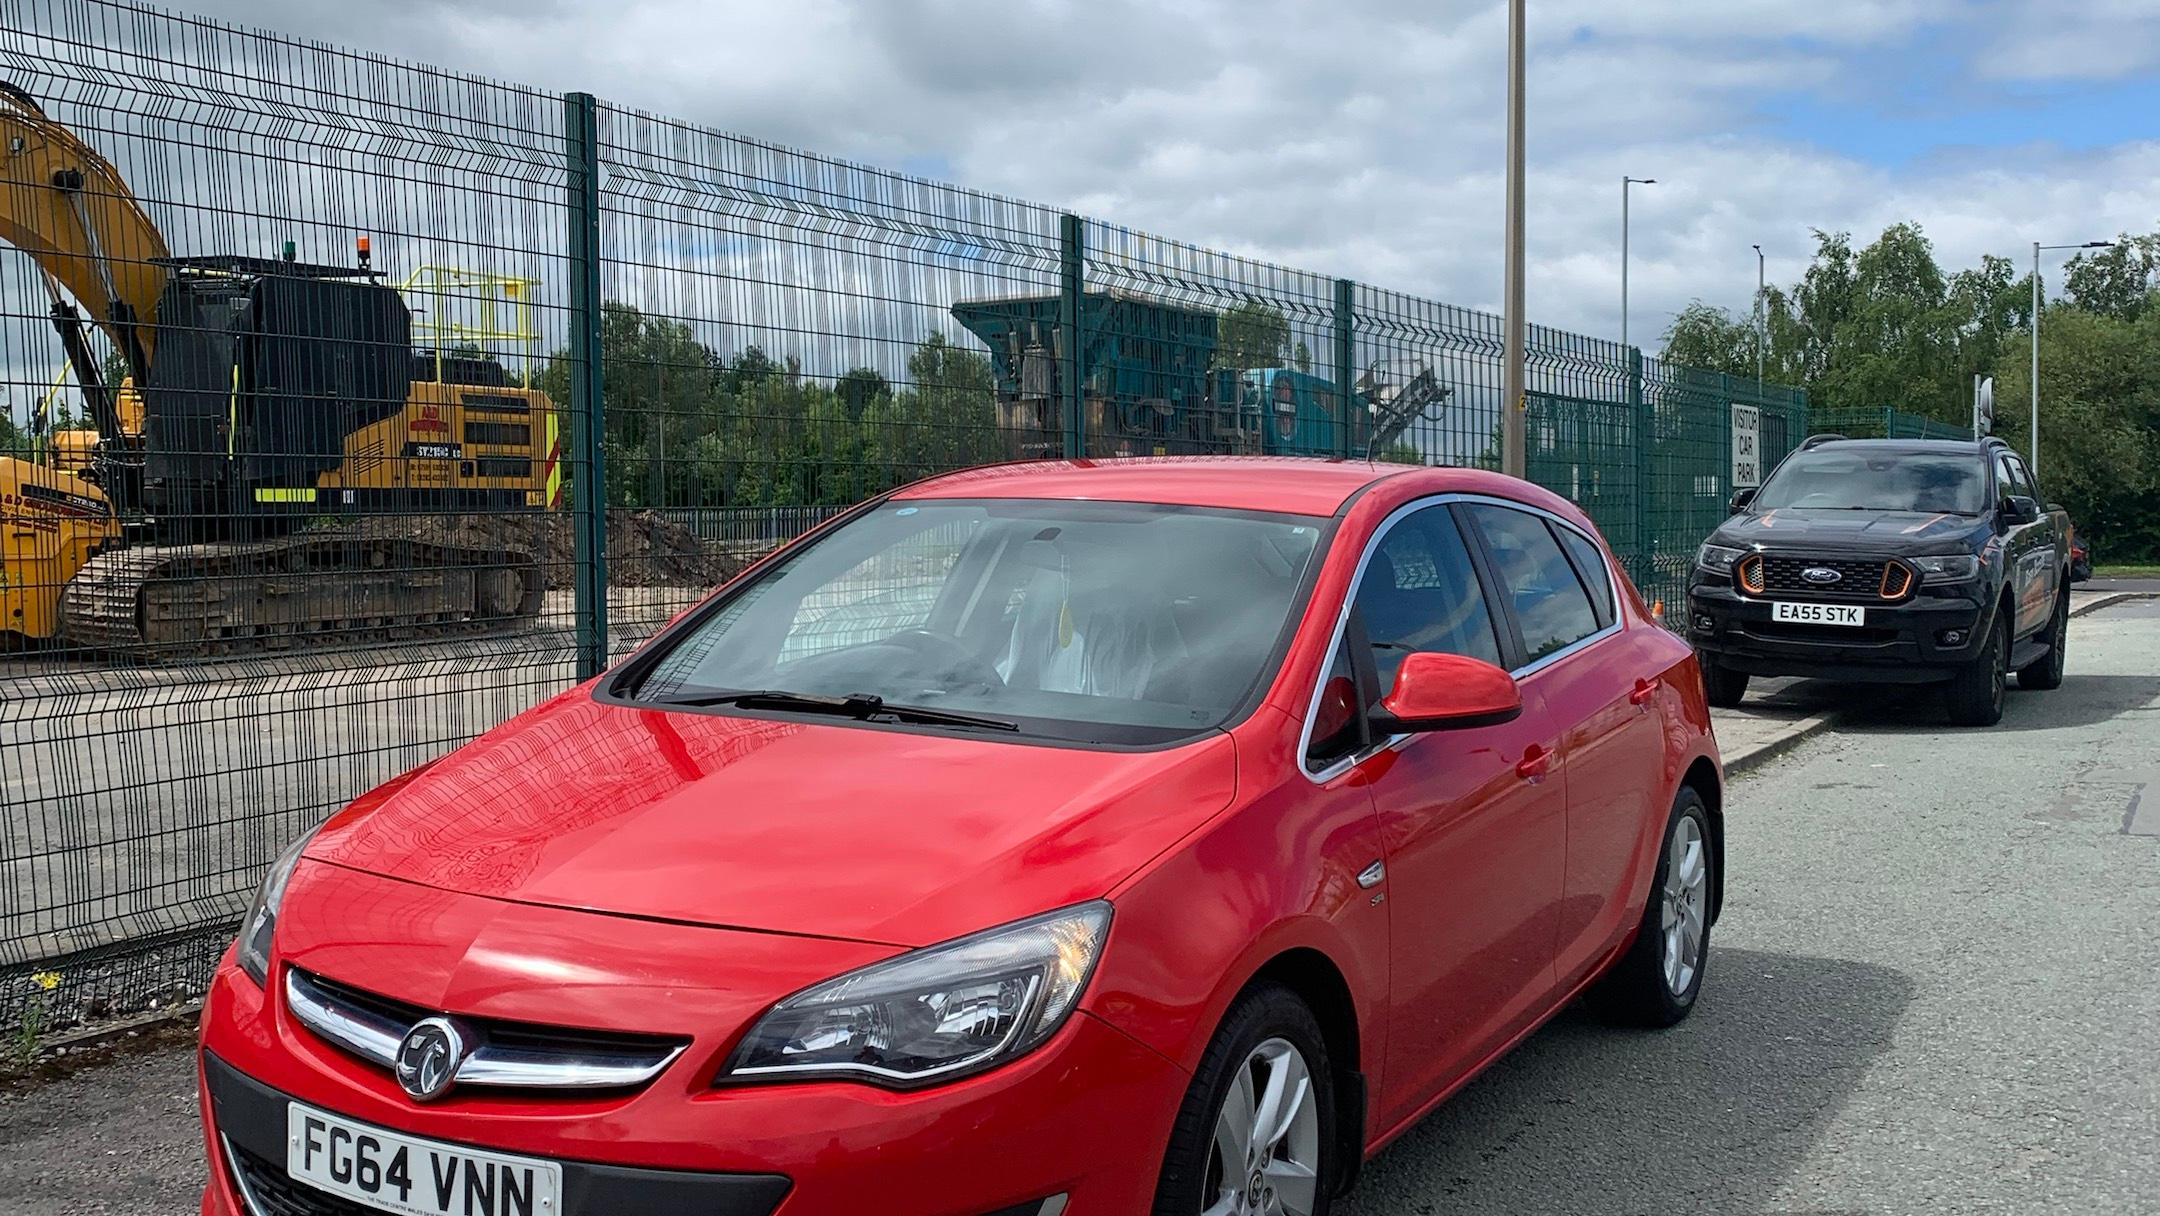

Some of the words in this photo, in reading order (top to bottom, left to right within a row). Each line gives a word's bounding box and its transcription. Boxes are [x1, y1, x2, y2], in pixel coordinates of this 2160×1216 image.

[1733, 407, 1758, 430] VISITOR
[1739, 435, 1753, 456] CAR
[1737, 462, 1755, 483] PARK
[1779, 604, 1822, 620] EA55
[1826, 606, 1858, 623] STK
[304, 1115, 412, 1202] FG64
[429, 1151, 534, 1216] VNN
